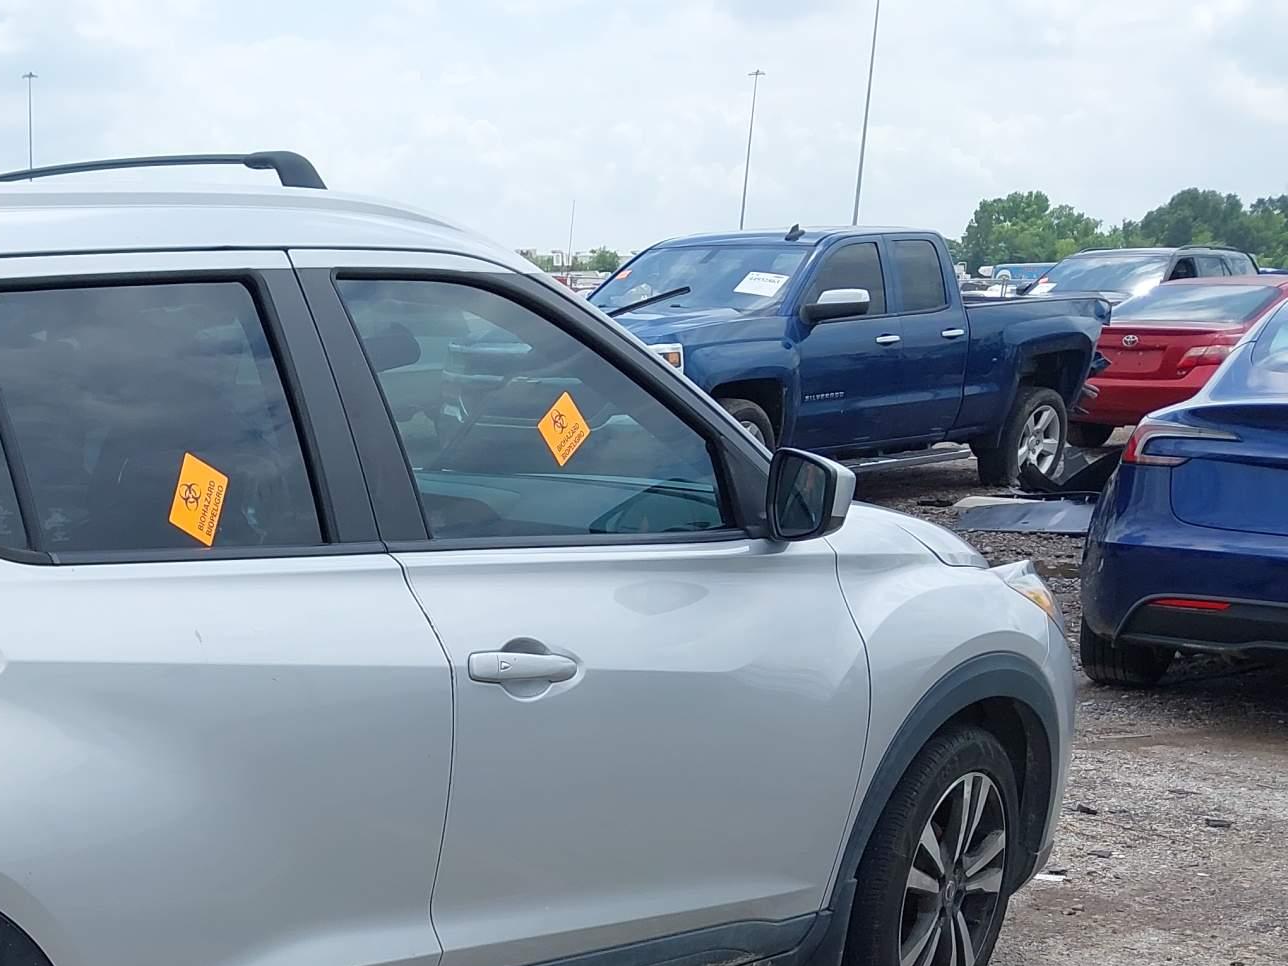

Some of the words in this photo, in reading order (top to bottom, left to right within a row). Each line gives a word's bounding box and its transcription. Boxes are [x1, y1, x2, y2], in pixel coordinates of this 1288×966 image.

[804, 391, 845, 401] SILVERADO
[556, 422, 579, 452] BIOHAZARD
[561, 430, 585, 460] BIOPELIGRO
[198, 480, 215, 532] BIOHAZARD
[205, 485, 224, 537] BIOPELIGRO
